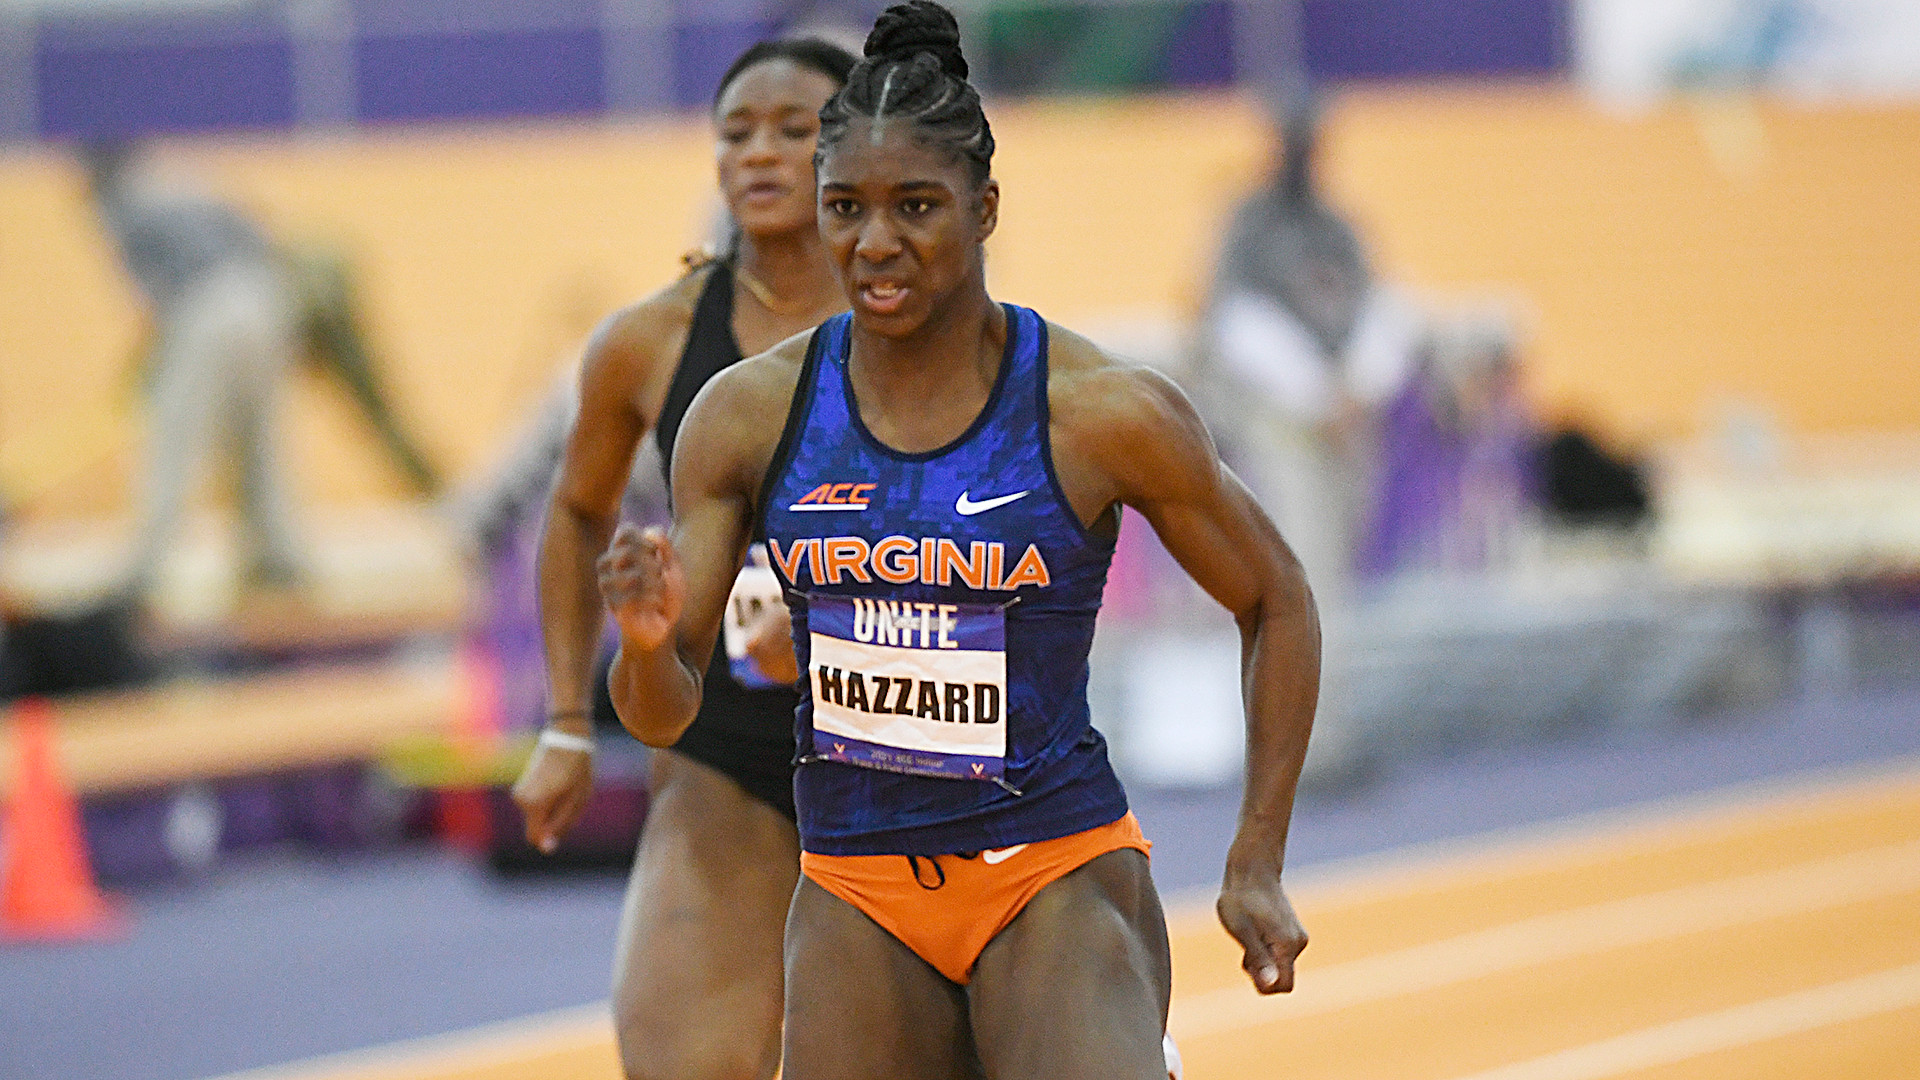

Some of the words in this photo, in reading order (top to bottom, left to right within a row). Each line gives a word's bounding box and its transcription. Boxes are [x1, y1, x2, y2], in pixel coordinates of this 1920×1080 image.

[798, 483, 877, 504] ACC
[769, 535, 1050, 590] VIRGINIA
[853, 597, 958, 649] UNITE
[819, 665, 1000, 724] HAZZARD
